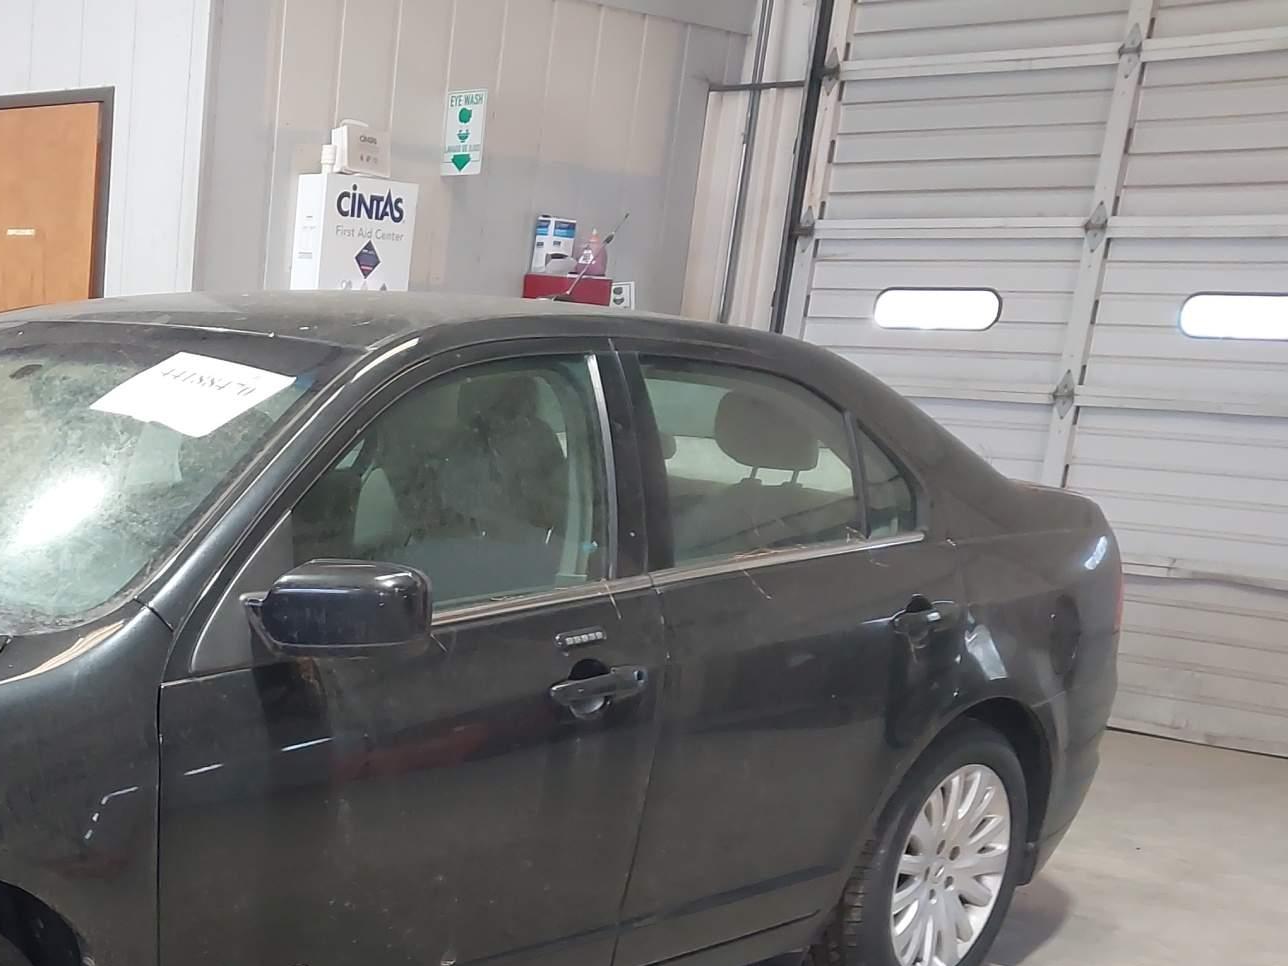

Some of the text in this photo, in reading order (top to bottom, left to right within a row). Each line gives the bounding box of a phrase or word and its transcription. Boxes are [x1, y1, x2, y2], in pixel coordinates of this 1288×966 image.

[450, 93, 484, 107] EYE WASH
[335, 225, 404, 241] First Aid Center
